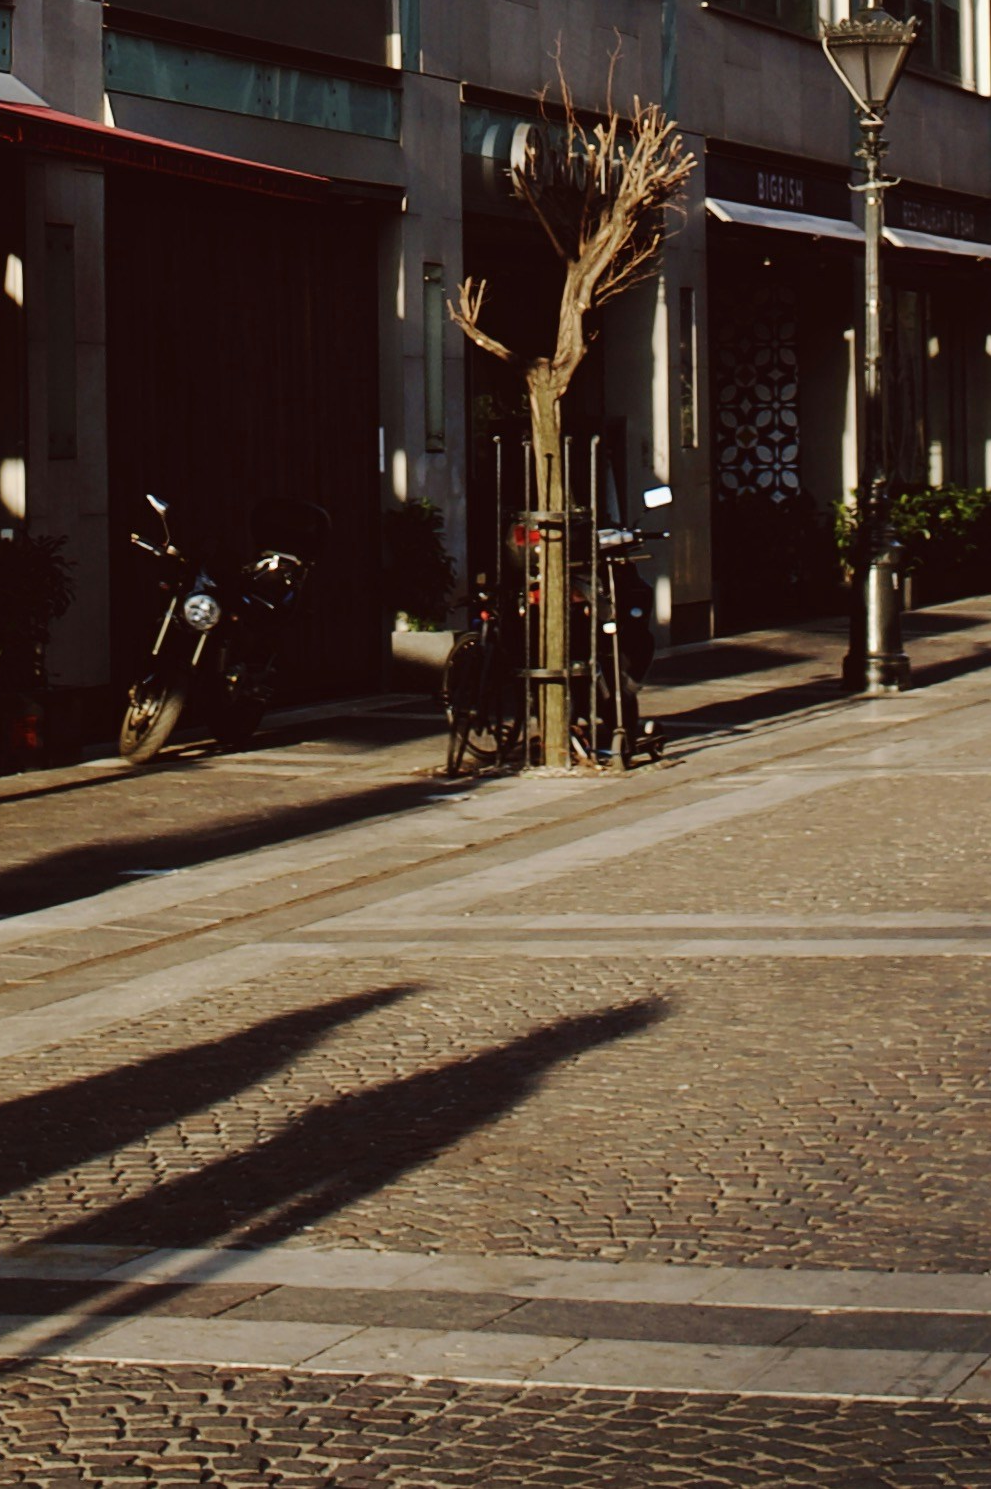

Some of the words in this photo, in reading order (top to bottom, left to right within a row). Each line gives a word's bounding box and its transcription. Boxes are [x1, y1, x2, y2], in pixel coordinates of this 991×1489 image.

[757, 171, 804, 208] BIGFISH
[903, 200, 951, 232] RESTAURANT
[960, 212, 975, 237] BAR
